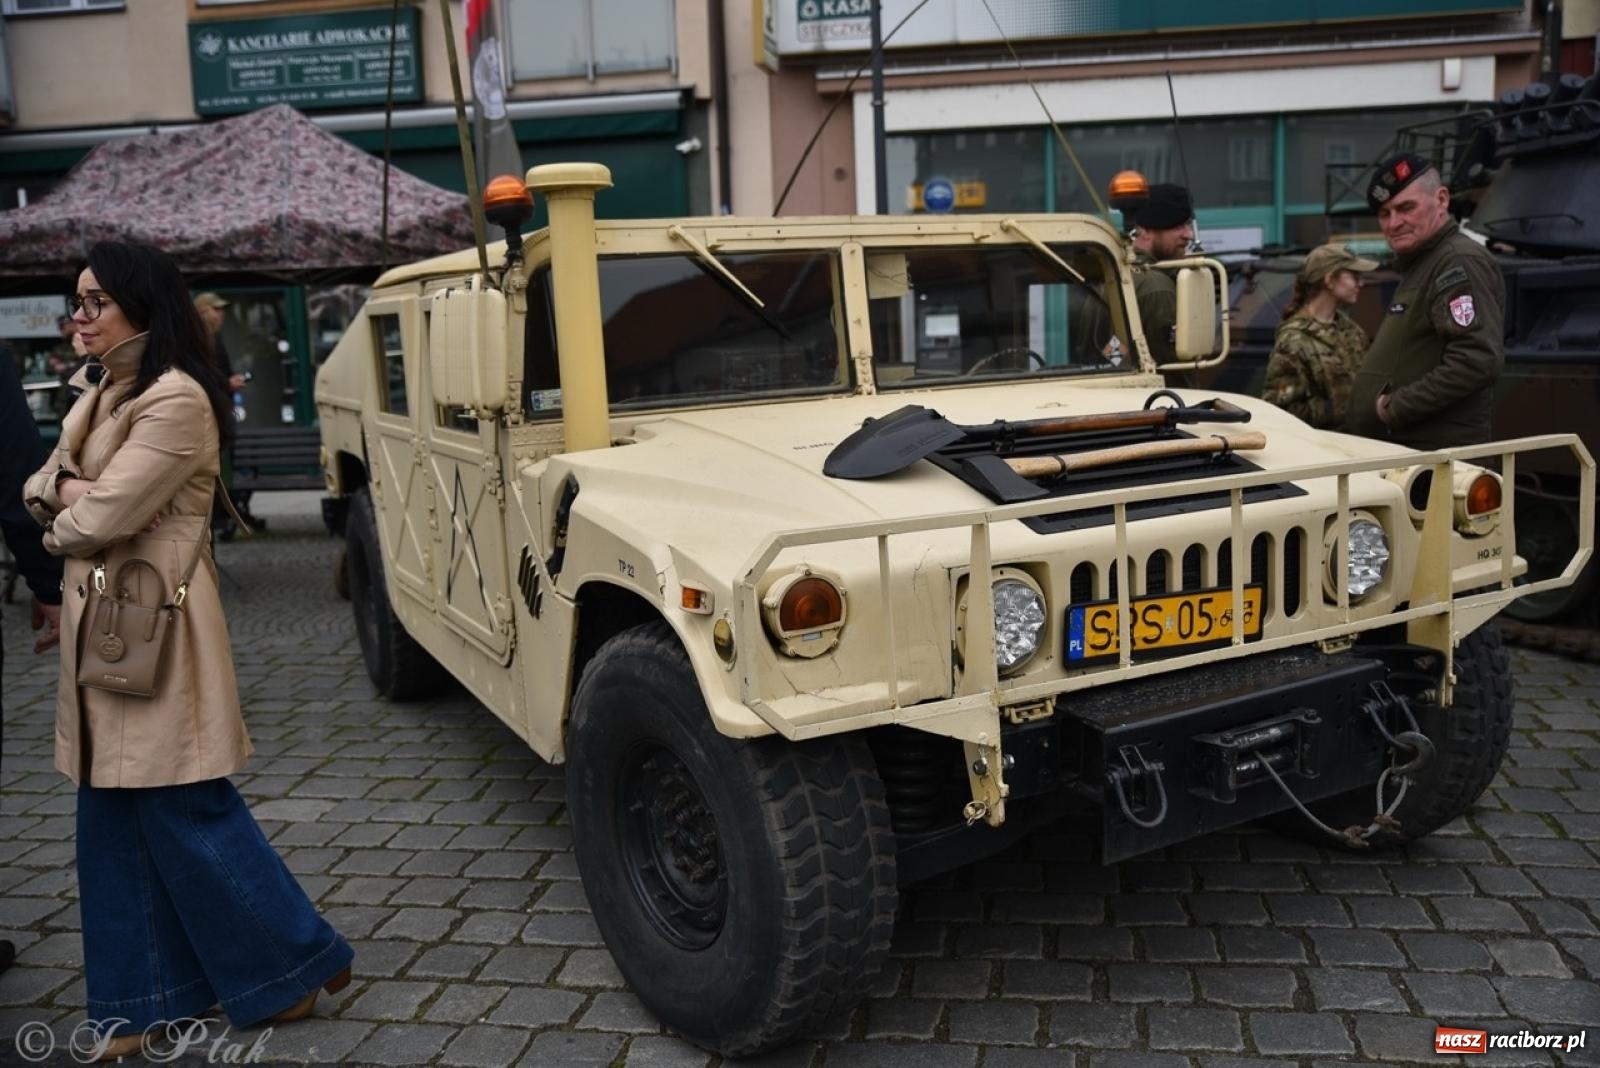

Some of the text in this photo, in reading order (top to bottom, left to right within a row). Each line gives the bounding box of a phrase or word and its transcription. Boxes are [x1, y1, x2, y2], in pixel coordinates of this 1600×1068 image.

[227, 24, 409, 51] KANCELARIE ADWOKACKIE
[618, 559, 635, 578] TP 22
[1177, 598, 1214, 640] 05
[1069, 640, 1083, 652] PL
